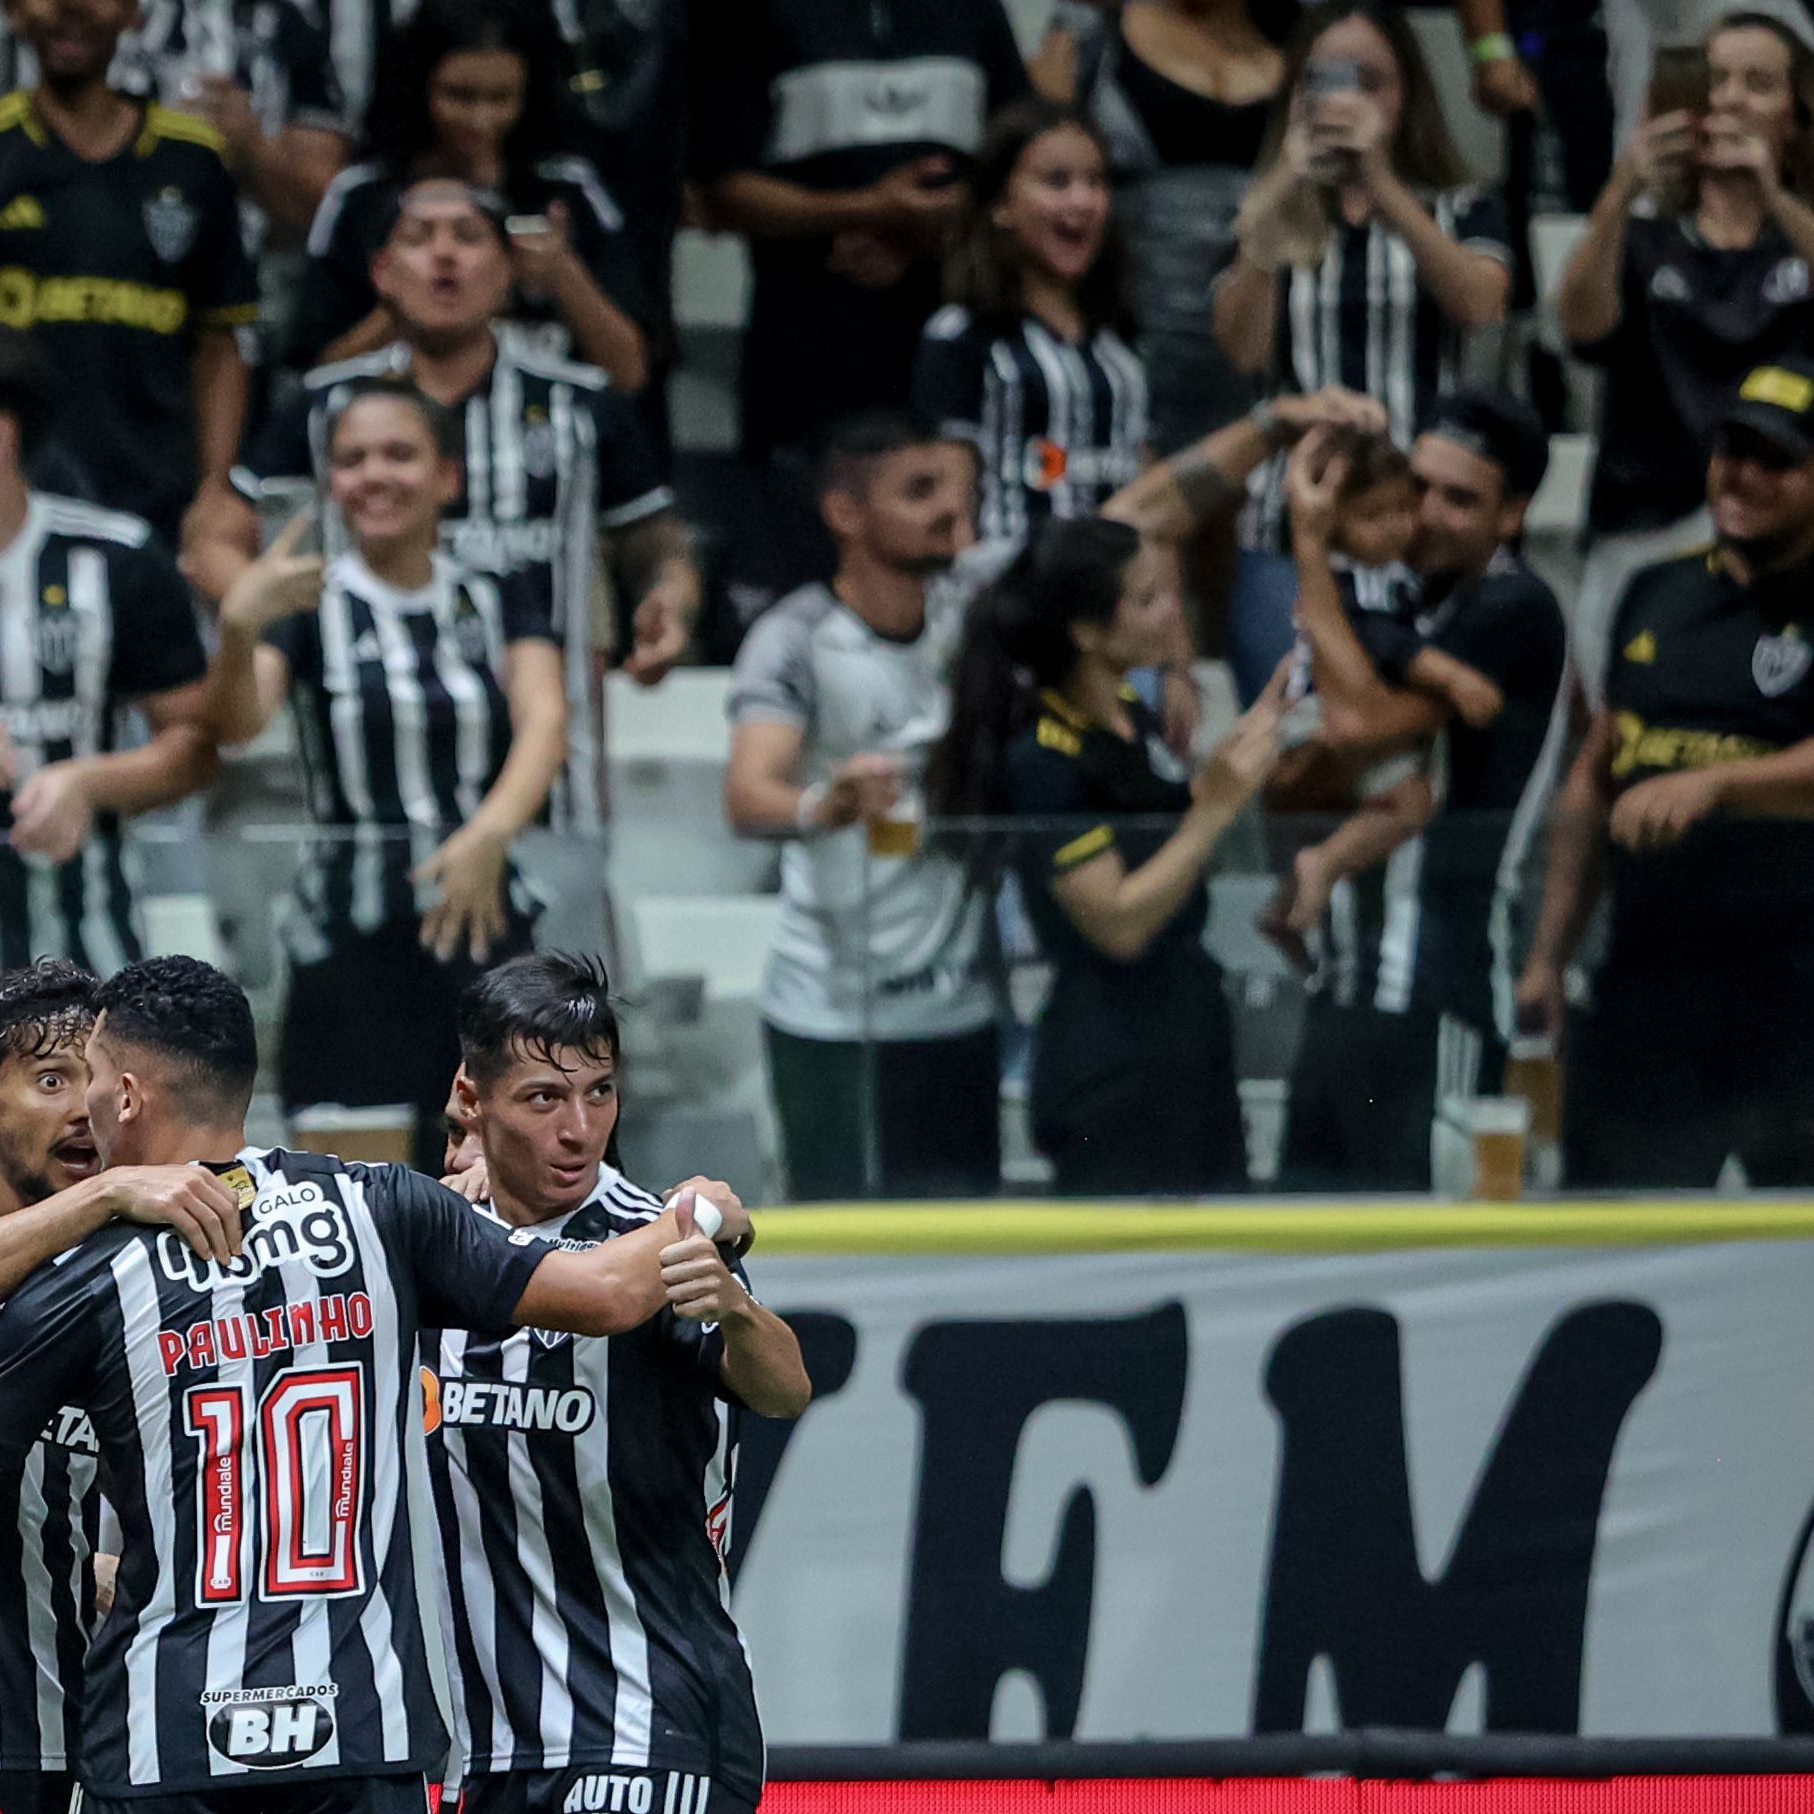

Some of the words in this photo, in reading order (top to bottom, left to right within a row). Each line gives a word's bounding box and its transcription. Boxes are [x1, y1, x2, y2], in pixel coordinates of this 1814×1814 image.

[258, 1187, 317, 1215] GALO
[157, 1292, 374, 1377] PAULINHO
[442, 1382, 594, 1433] BETANO
[182, 1361, 368, 1611] 10
[213, 1456, 233, 1533] mundiale
[334, 1441, 355, 1518] mundiale
[202, 1684, 338, 1704] SUPERMERCADOS
[228, 1704, 318, 1757] BH
